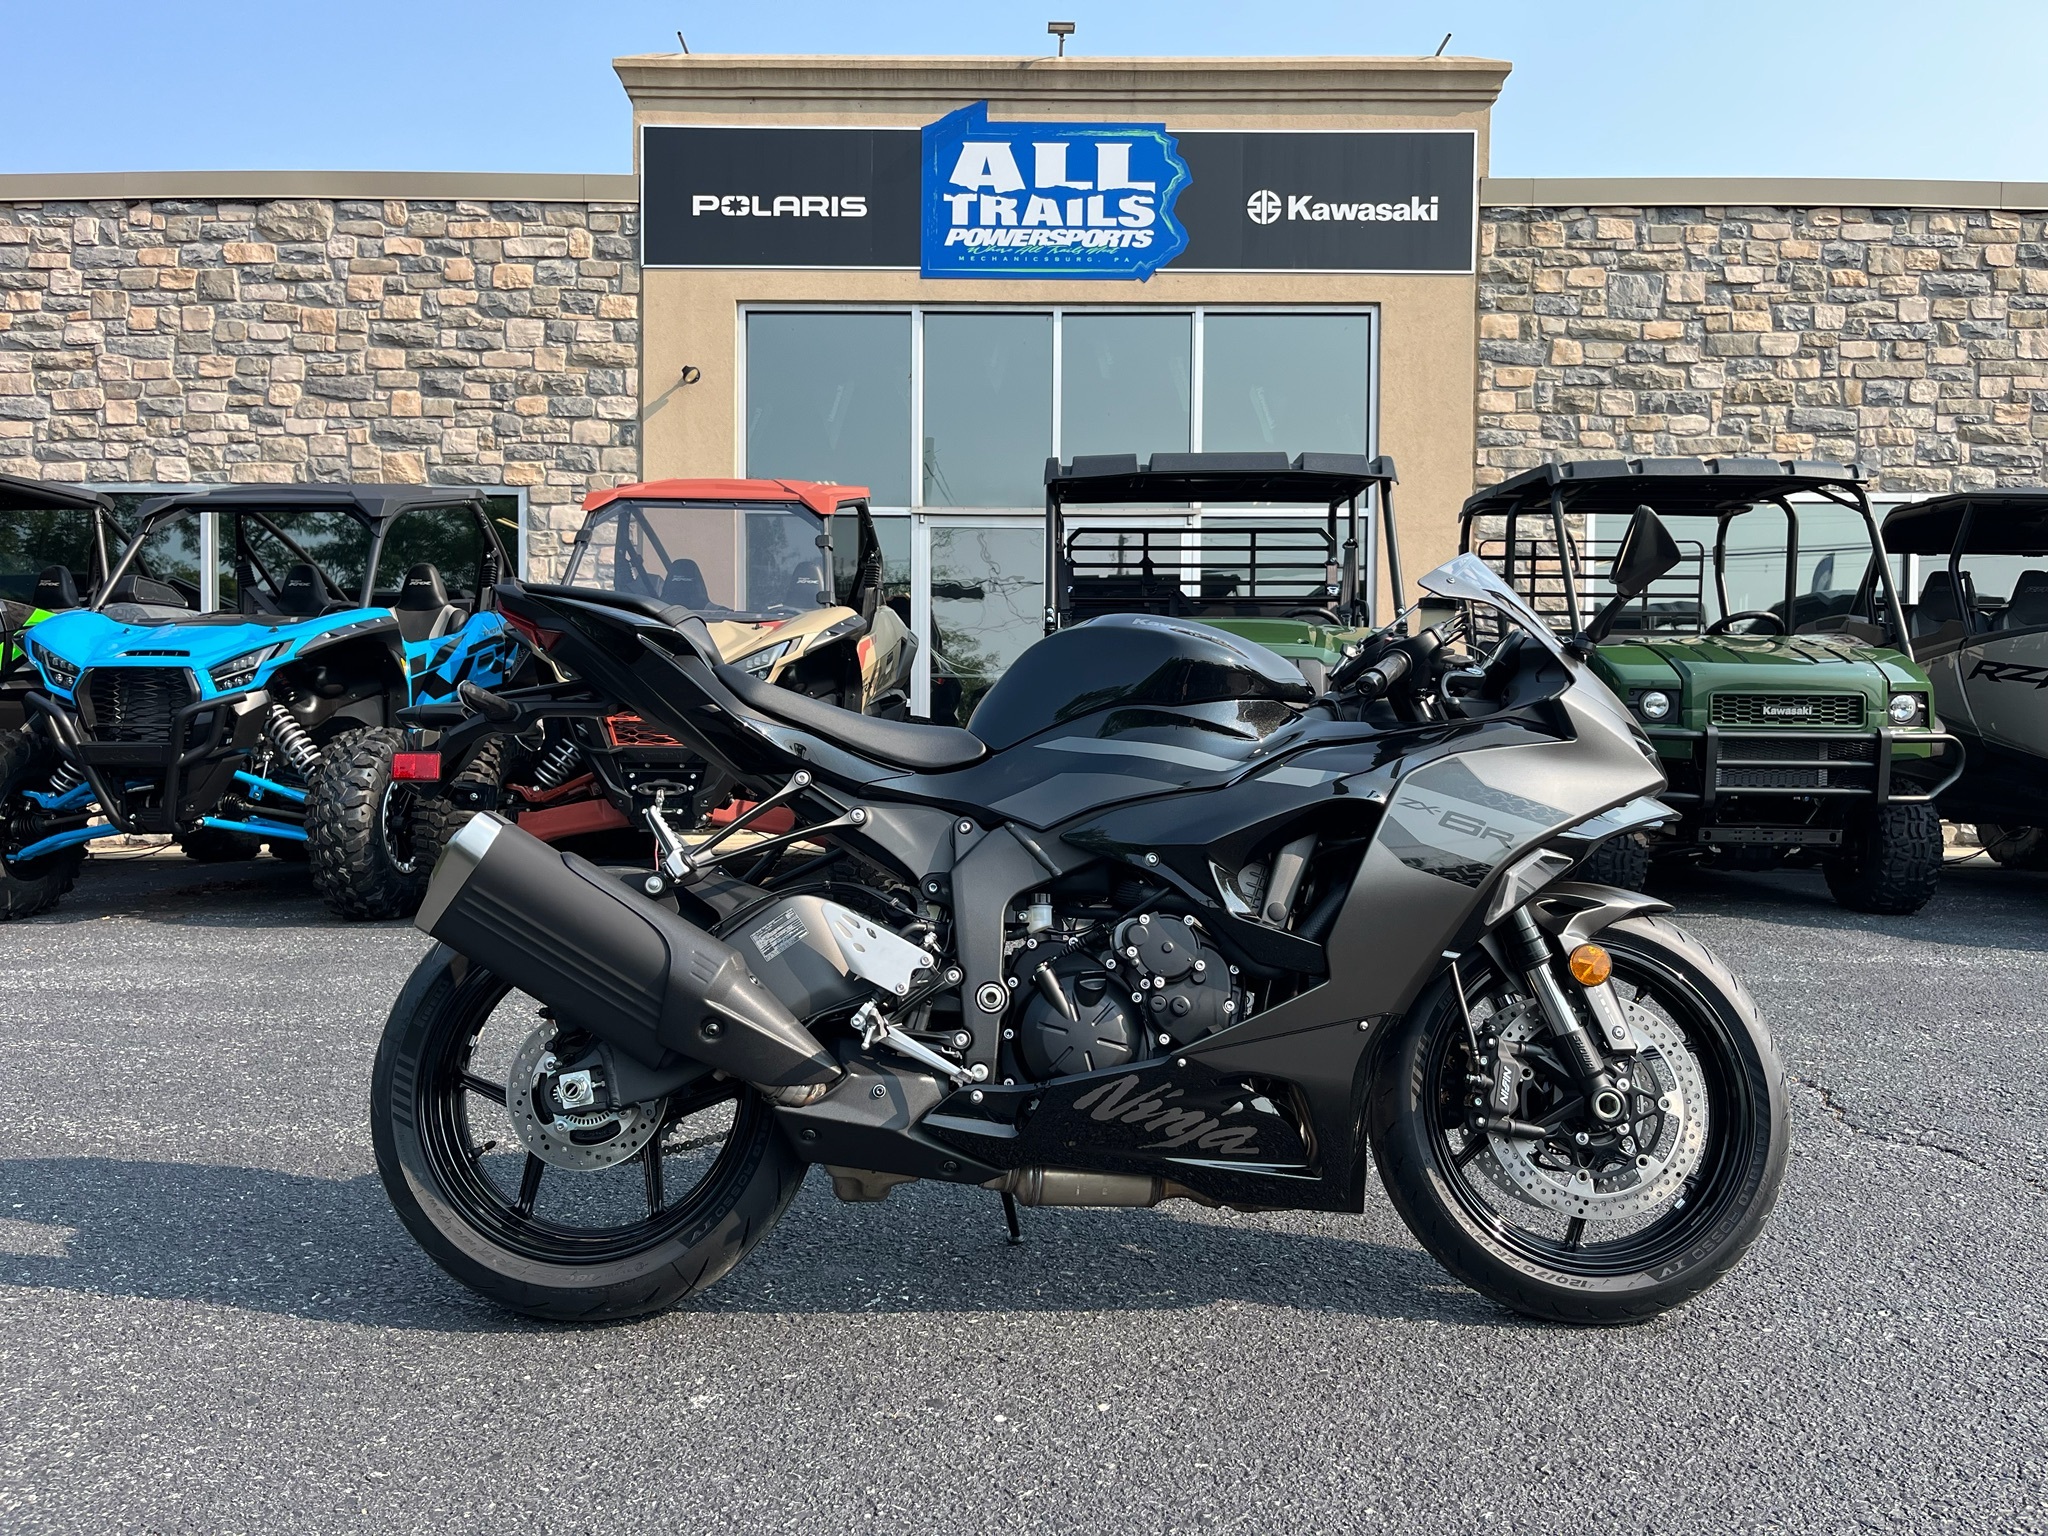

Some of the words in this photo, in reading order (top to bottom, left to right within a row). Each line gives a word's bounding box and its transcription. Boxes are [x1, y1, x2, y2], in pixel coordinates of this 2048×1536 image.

[949, 142, 1156, 193] ALL
[692, 195, 868, 217] POLARIS
[943, 194, 1156, 228] TRAILS
[1288, 195, 1439, 222] Kawasaki
[944, 228, 1155, 248] POWERSPORTS
[1762, 706, 1812, 715] Kawasaki
[1573, 1035, 1596, 1070] SHOWA
[1073, 1074, 1260, 1154] Ninja
[1690, 1210, 1740, 1261] ROSSO
[1522, 1264, 1588, 1288] 120/70
[1658, 1258, 1687, 1279] IV
